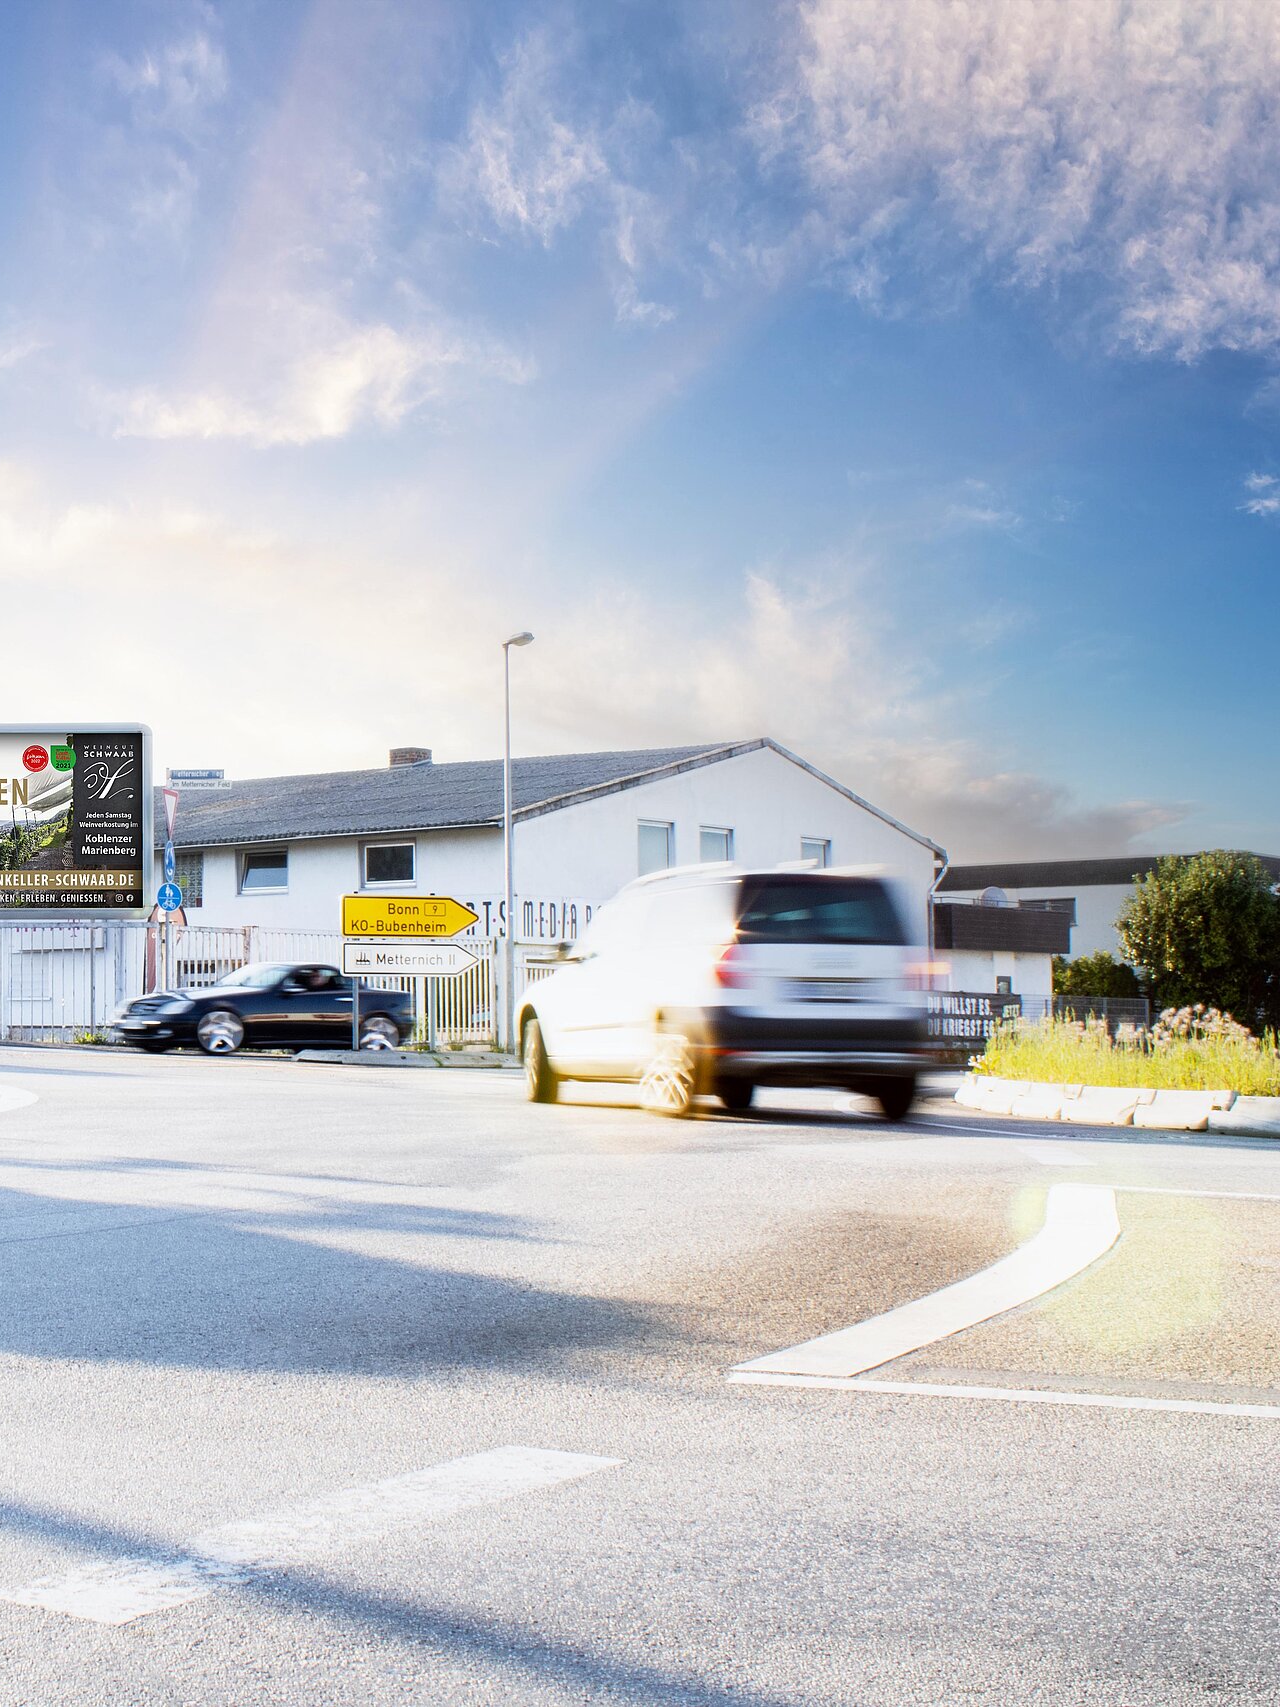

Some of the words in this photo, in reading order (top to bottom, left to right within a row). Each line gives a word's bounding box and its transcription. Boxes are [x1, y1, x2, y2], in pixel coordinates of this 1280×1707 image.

[105, 812, 132, 820] Samstag
[79, 821, 129, 829] Weinverkostung
[85, 834, 133, 843] Koblenzer
[81, 846, 136, 856] Marienberg
[20, 894, 58, 903] ERLEBEN.
[61, 894, 106, 903] GENIESSEN.
[388, 903, 419, 915] Bonn
[432, 905, 438, 914] 9
[351, 920, 447, 932] KO-Bubenheim
[376, 954, 443, 965] Metternich
[927, 996, 940, 1014] DU
[942, 997, 976, 1015] WILLST
[979, 999, 993, 1016] ES.
[927, 1018, 940, 1036] DU
[942, 1019, 981, 1037] KRIEGST
